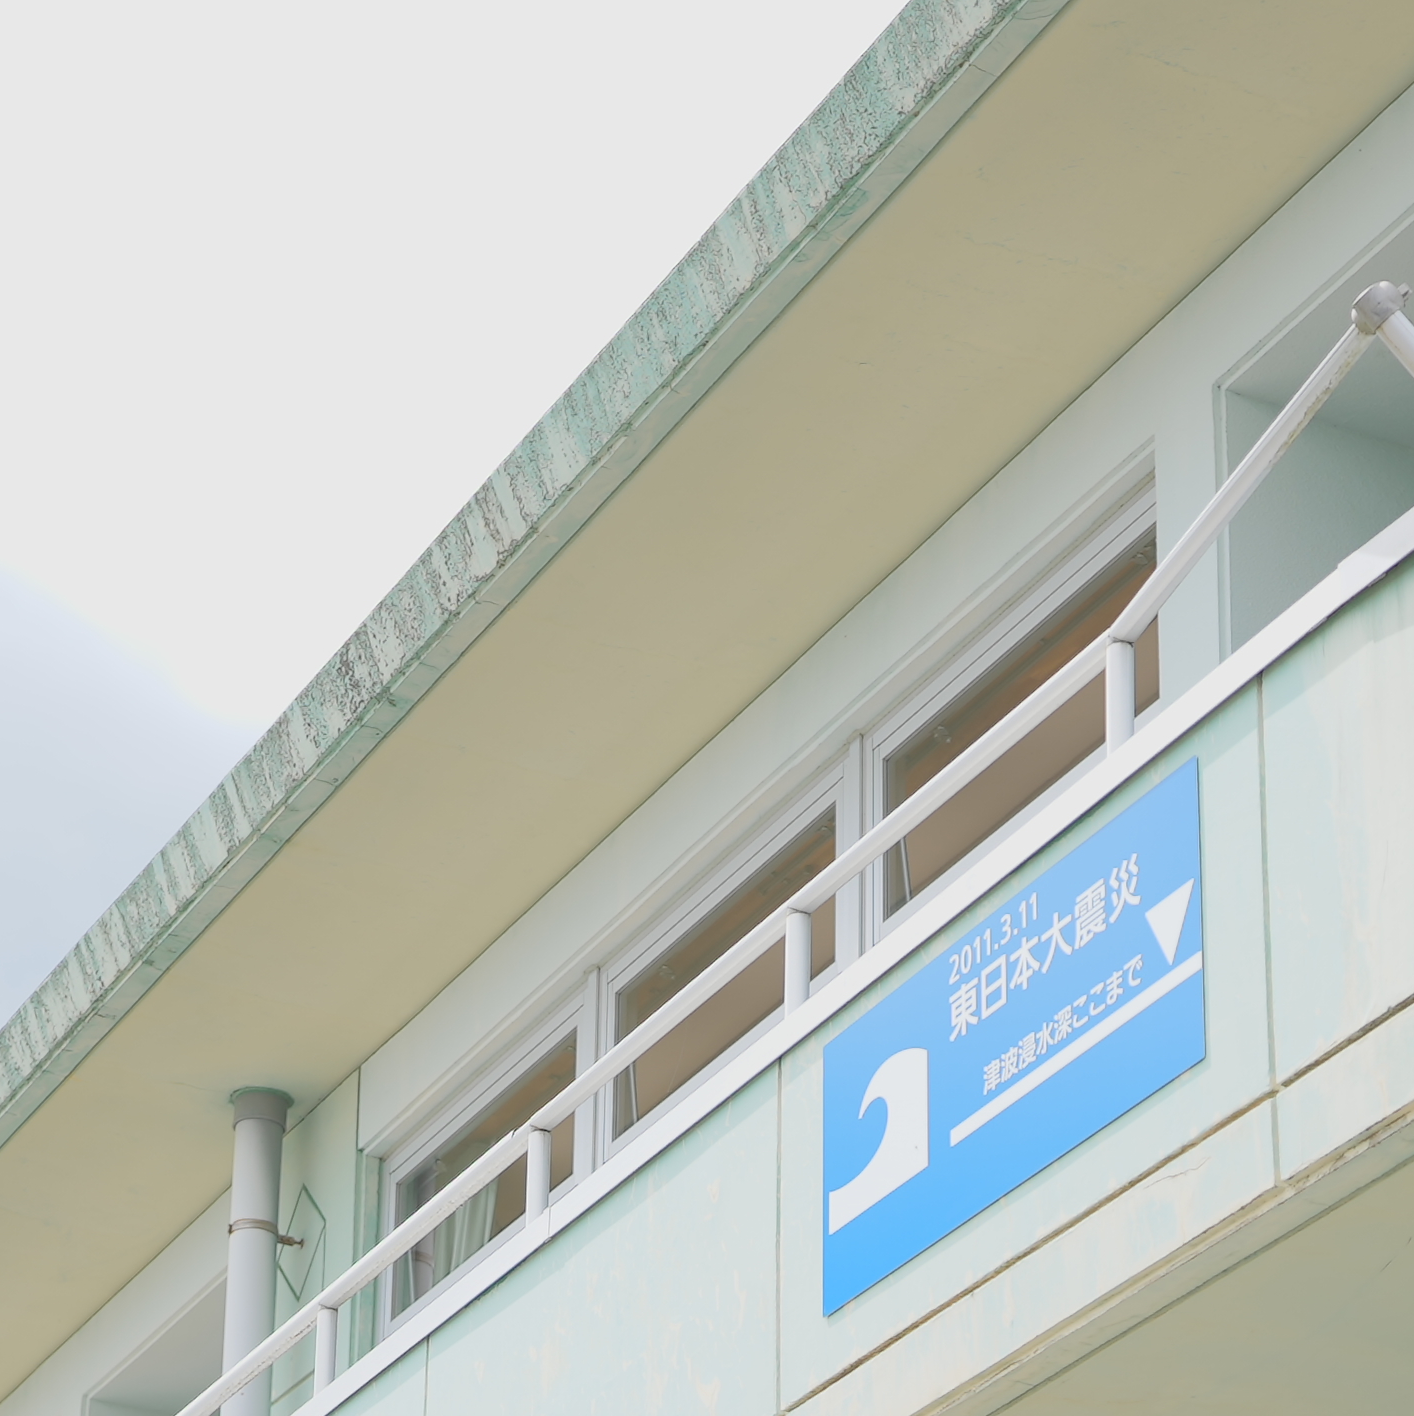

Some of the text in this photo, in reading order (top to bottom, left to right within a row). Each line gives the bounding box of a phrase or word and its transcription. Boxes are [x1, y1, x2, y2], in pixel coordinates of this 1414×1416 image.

[949, 891, 1039, 986] 2011.3.11
[949, 853, 1142, 1042] 東日本大震災
[983, 954, 1144, 1096] 津波浸水深ここまで
